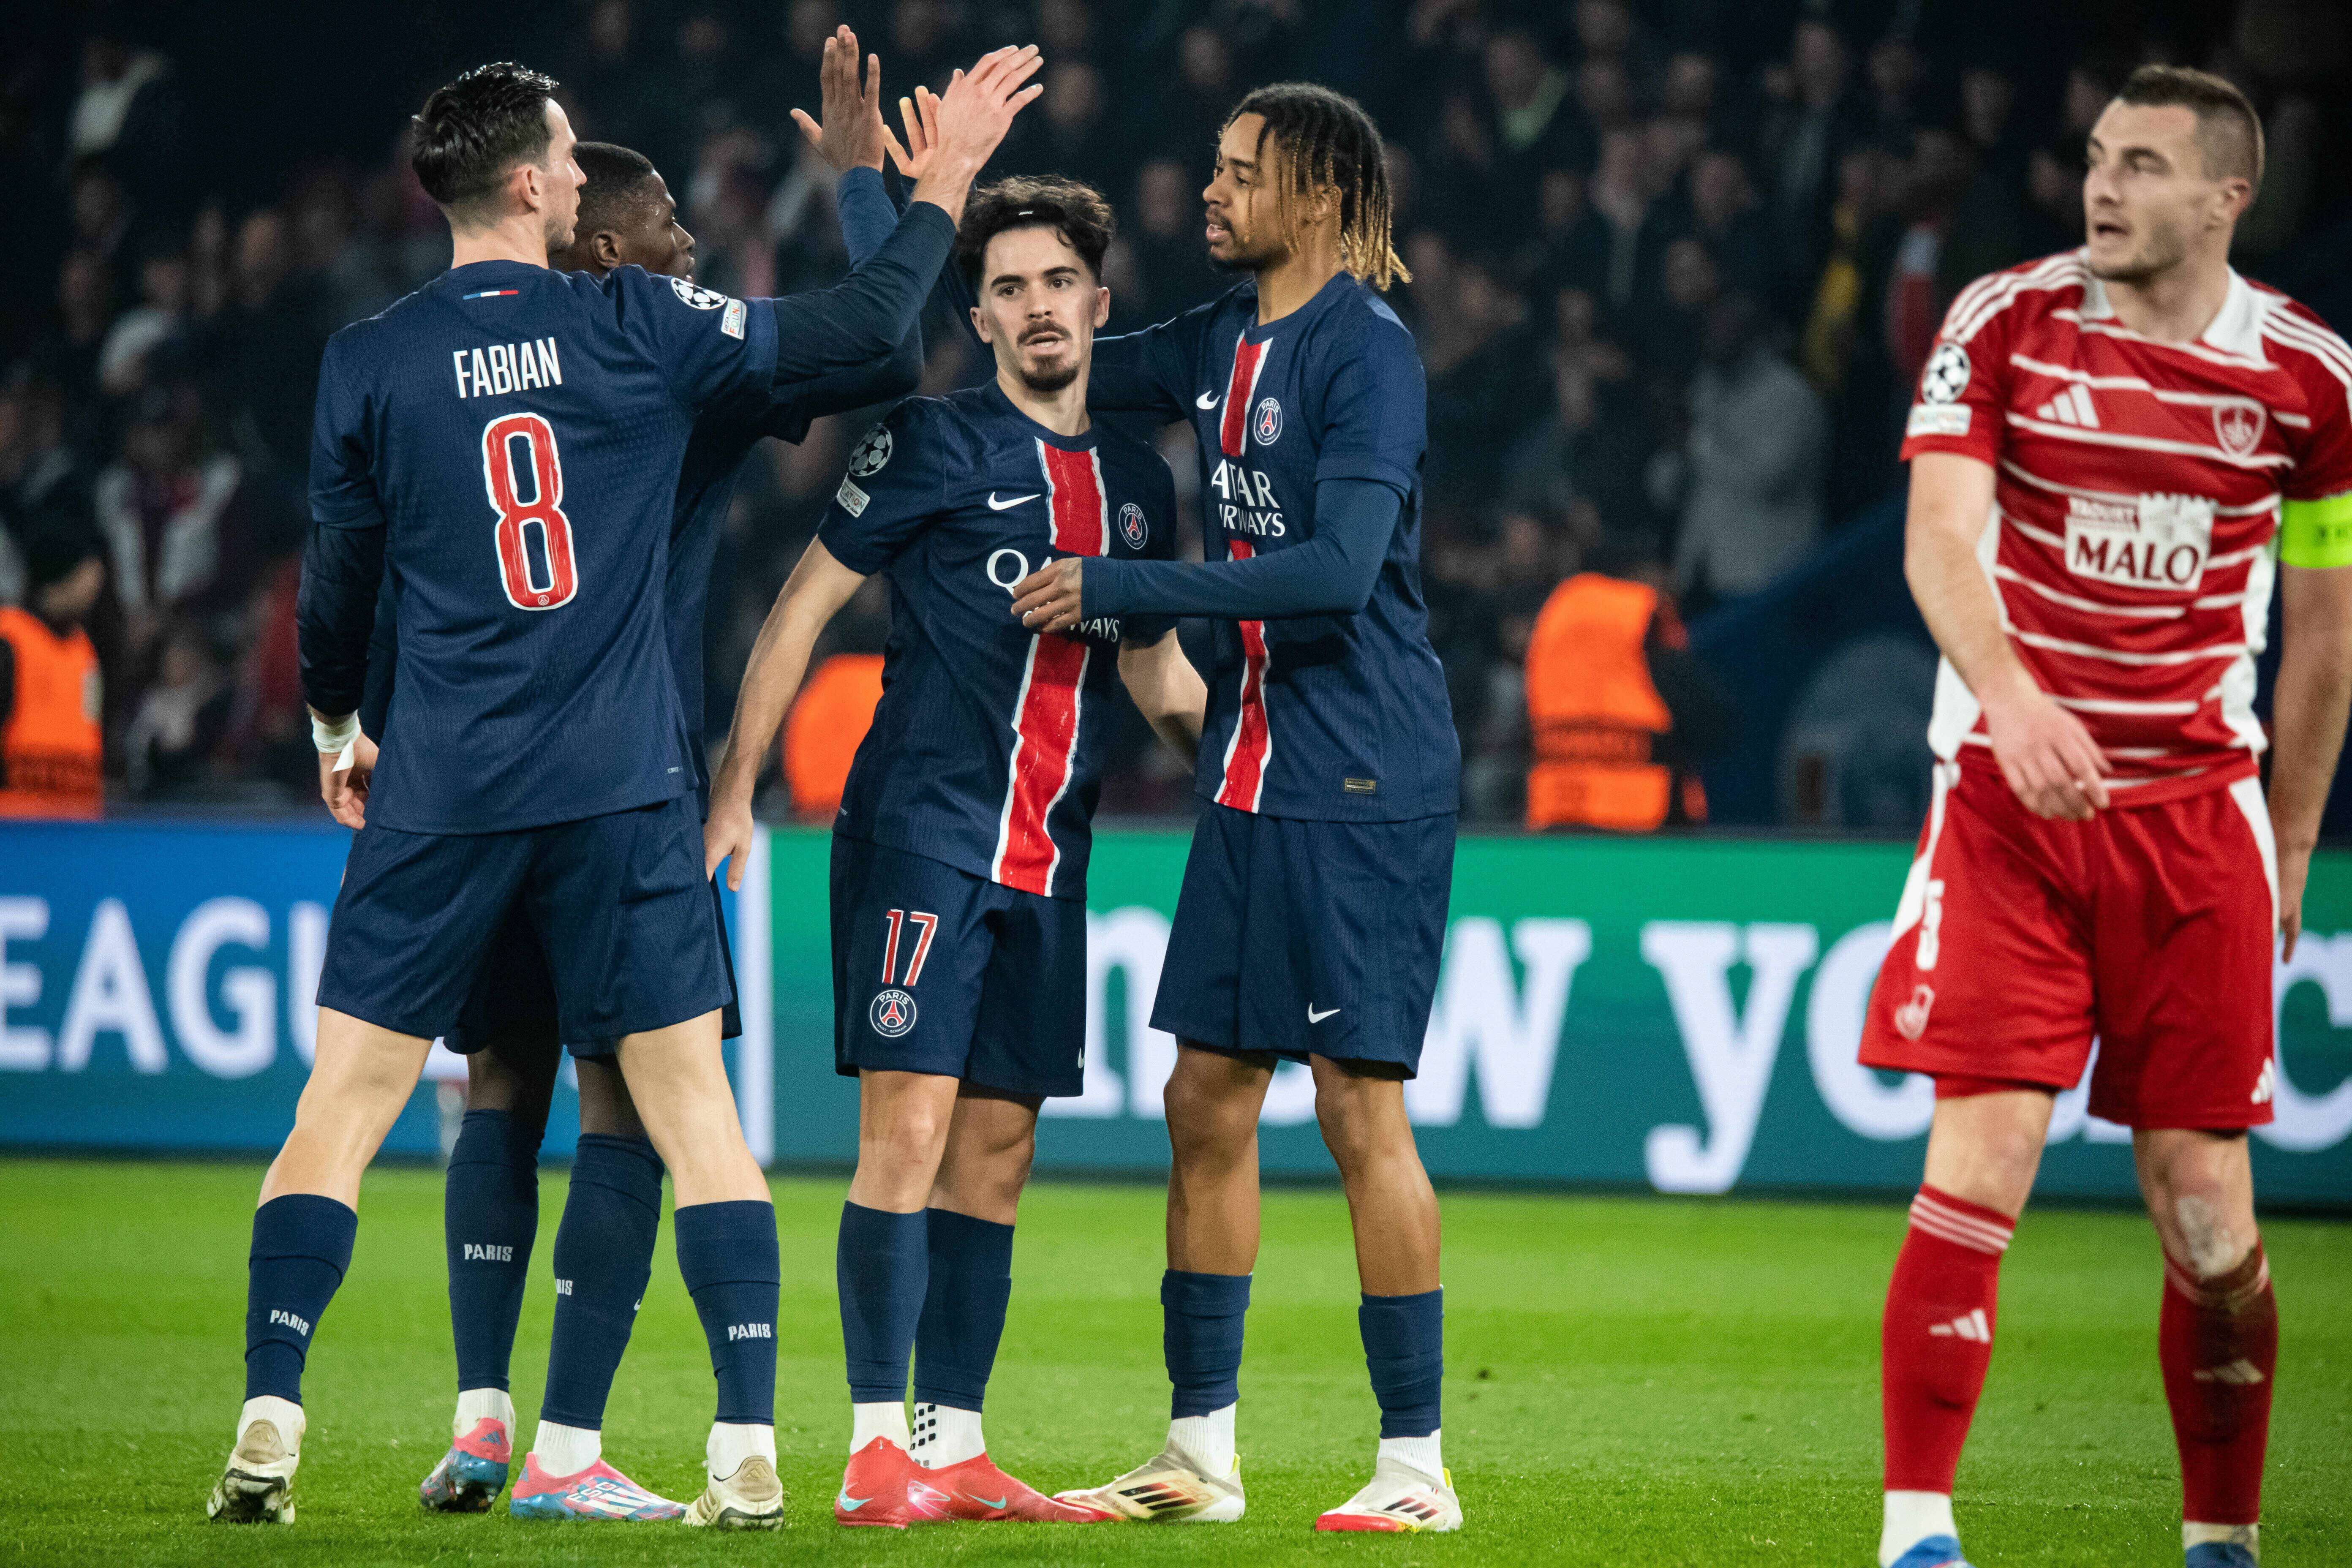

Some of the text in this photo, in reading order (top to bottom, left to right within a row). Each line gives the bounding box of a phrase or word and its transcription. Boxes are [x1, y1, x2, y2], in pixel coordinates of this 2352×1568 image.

[453, 337, 562, 398] FABIAN
[1261, 400, 1279, 413] PARIS
[1211, 459, 1280, 509] ATAR
[482, 412, 578, 611] 8
[1123, 506, 1142, 520] PARIS
[2074, 534, 2200, 585] MALO
[882, 909, 938, 986] 17
[879, 992, 909, 1004] PARIS
[1037, 905, 1592, 1130] nw
[464, 1244, 513, 1262] PARIS
[556, 1279, 573, 1296] RIS
[270, 1310, 310, 1337] PARIS
[728, 1323, 771, 1341] PARIS
